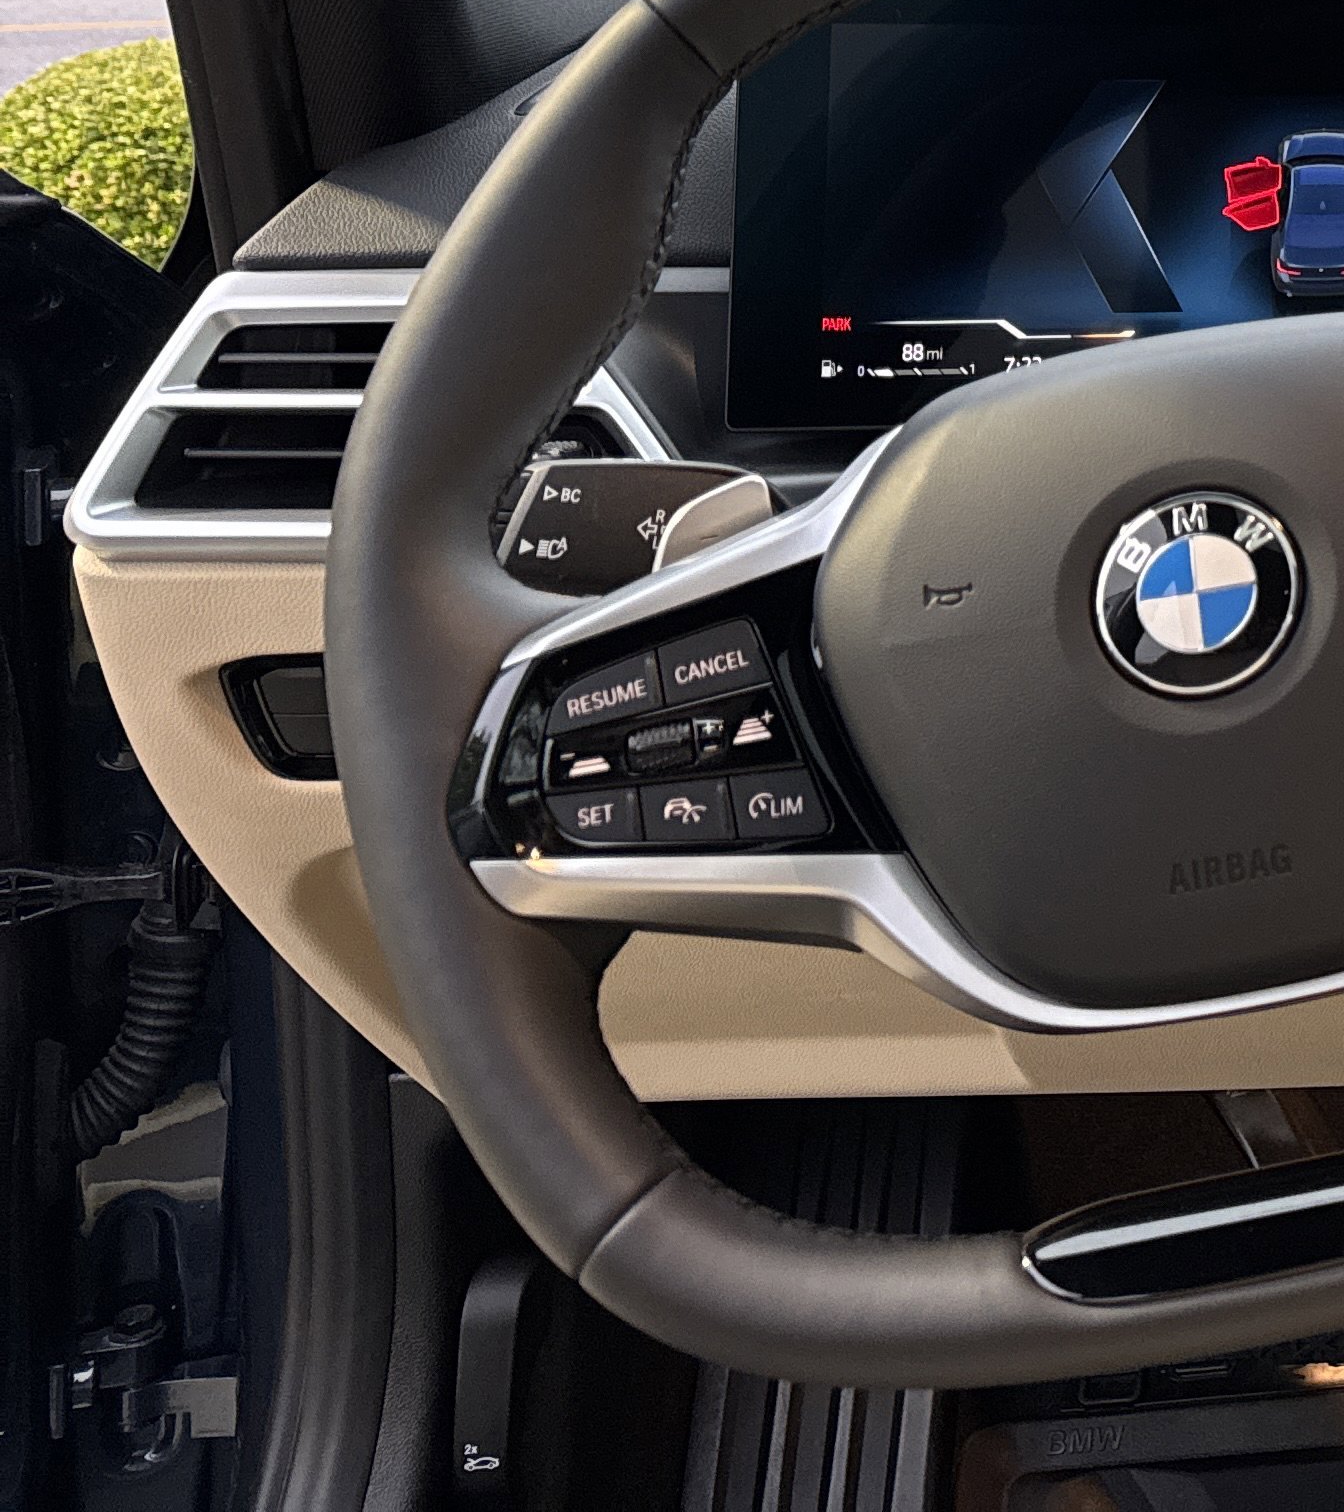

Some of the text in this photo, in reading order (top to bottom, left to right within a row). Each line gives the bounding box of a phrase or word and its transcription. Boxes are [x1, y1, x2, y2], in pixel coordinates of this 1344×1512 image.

[822, 317, 851, 331] PARK
[901, 343, 924, 362] 88
[857, 364, 865, 377] 0
[560, 487, 582, 503] BC
[1115, 499, 1274, 575] BMW
[674, 649, 750, 685] CANCEL
[566, 678, 648, 719] RESUME
[577, 803, 615, 830] SET
[770, 795, 804, 819] LIM
[1168, 842, 1294, 896] AIRBAG
[464, 1443, 478, 1455] 2x
[1048, 1424, 1126, 1456] BMW
